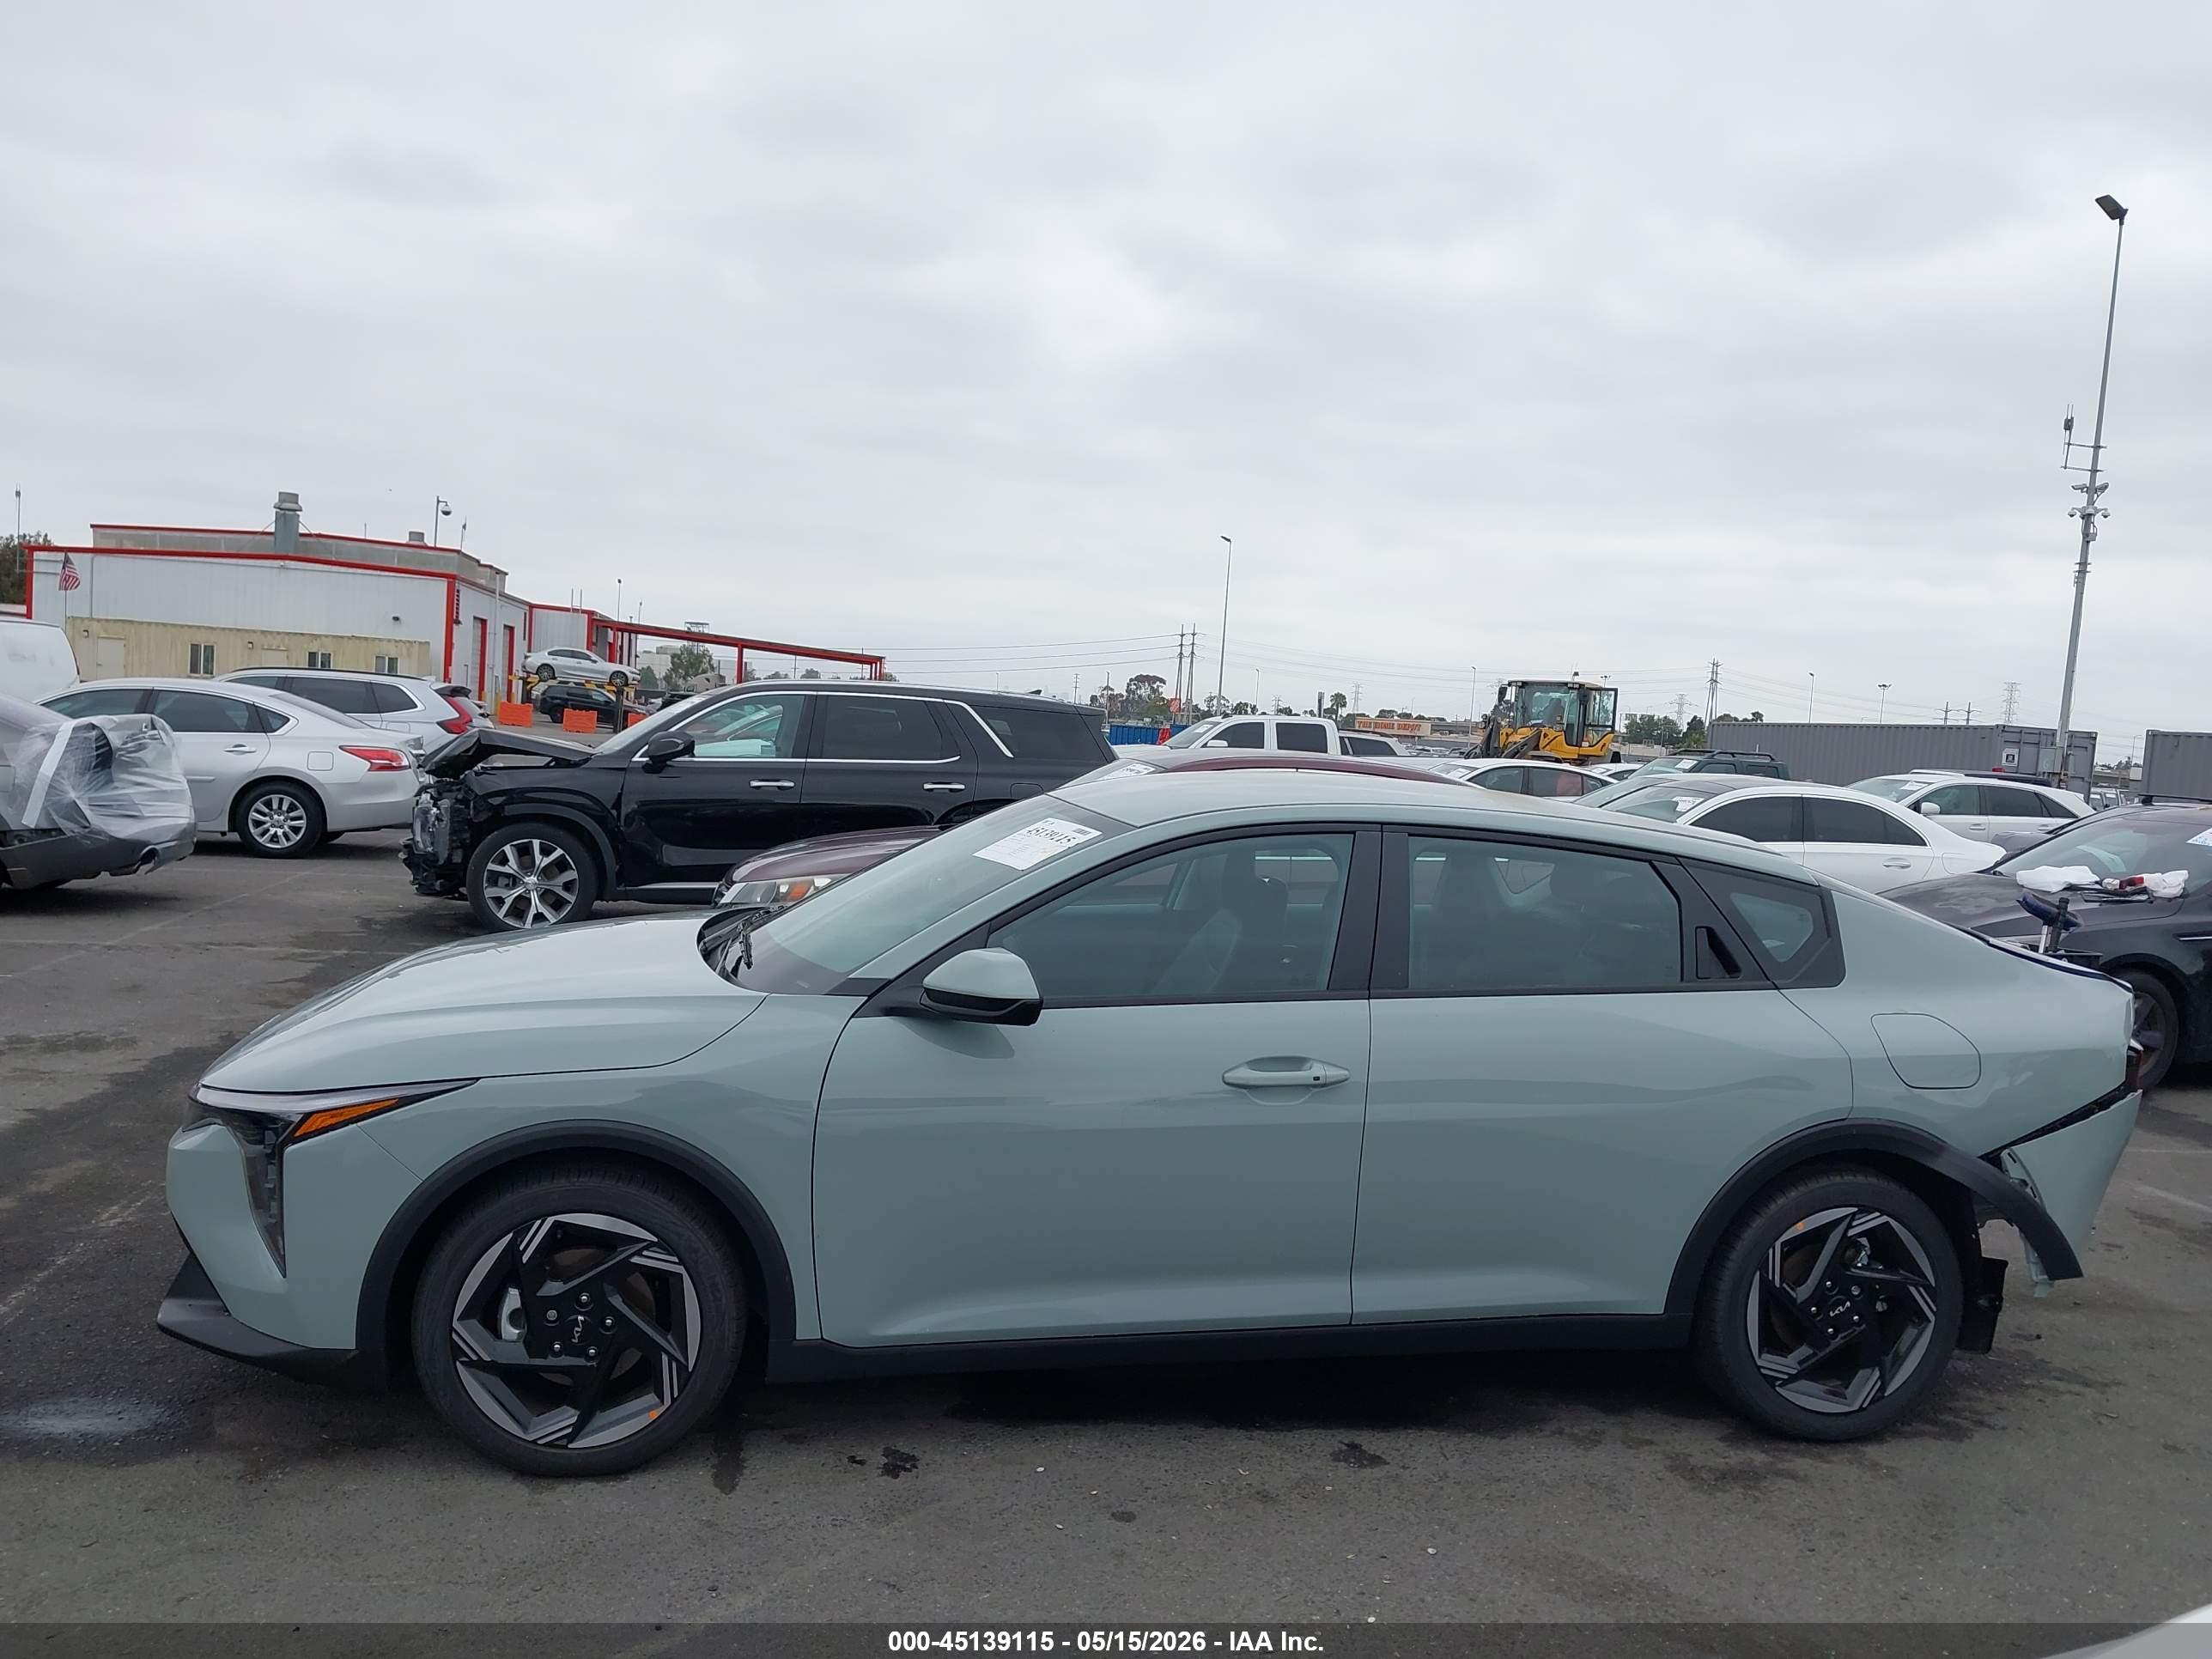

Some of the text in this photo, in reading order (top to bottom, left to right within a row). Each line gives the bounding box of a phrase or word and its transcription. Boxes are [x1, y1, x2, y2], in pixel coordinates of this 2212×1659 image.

[1358, 720, 1422, 732] THE HOME DEPOT
[1026, 826, 1077, 845] 45139115
